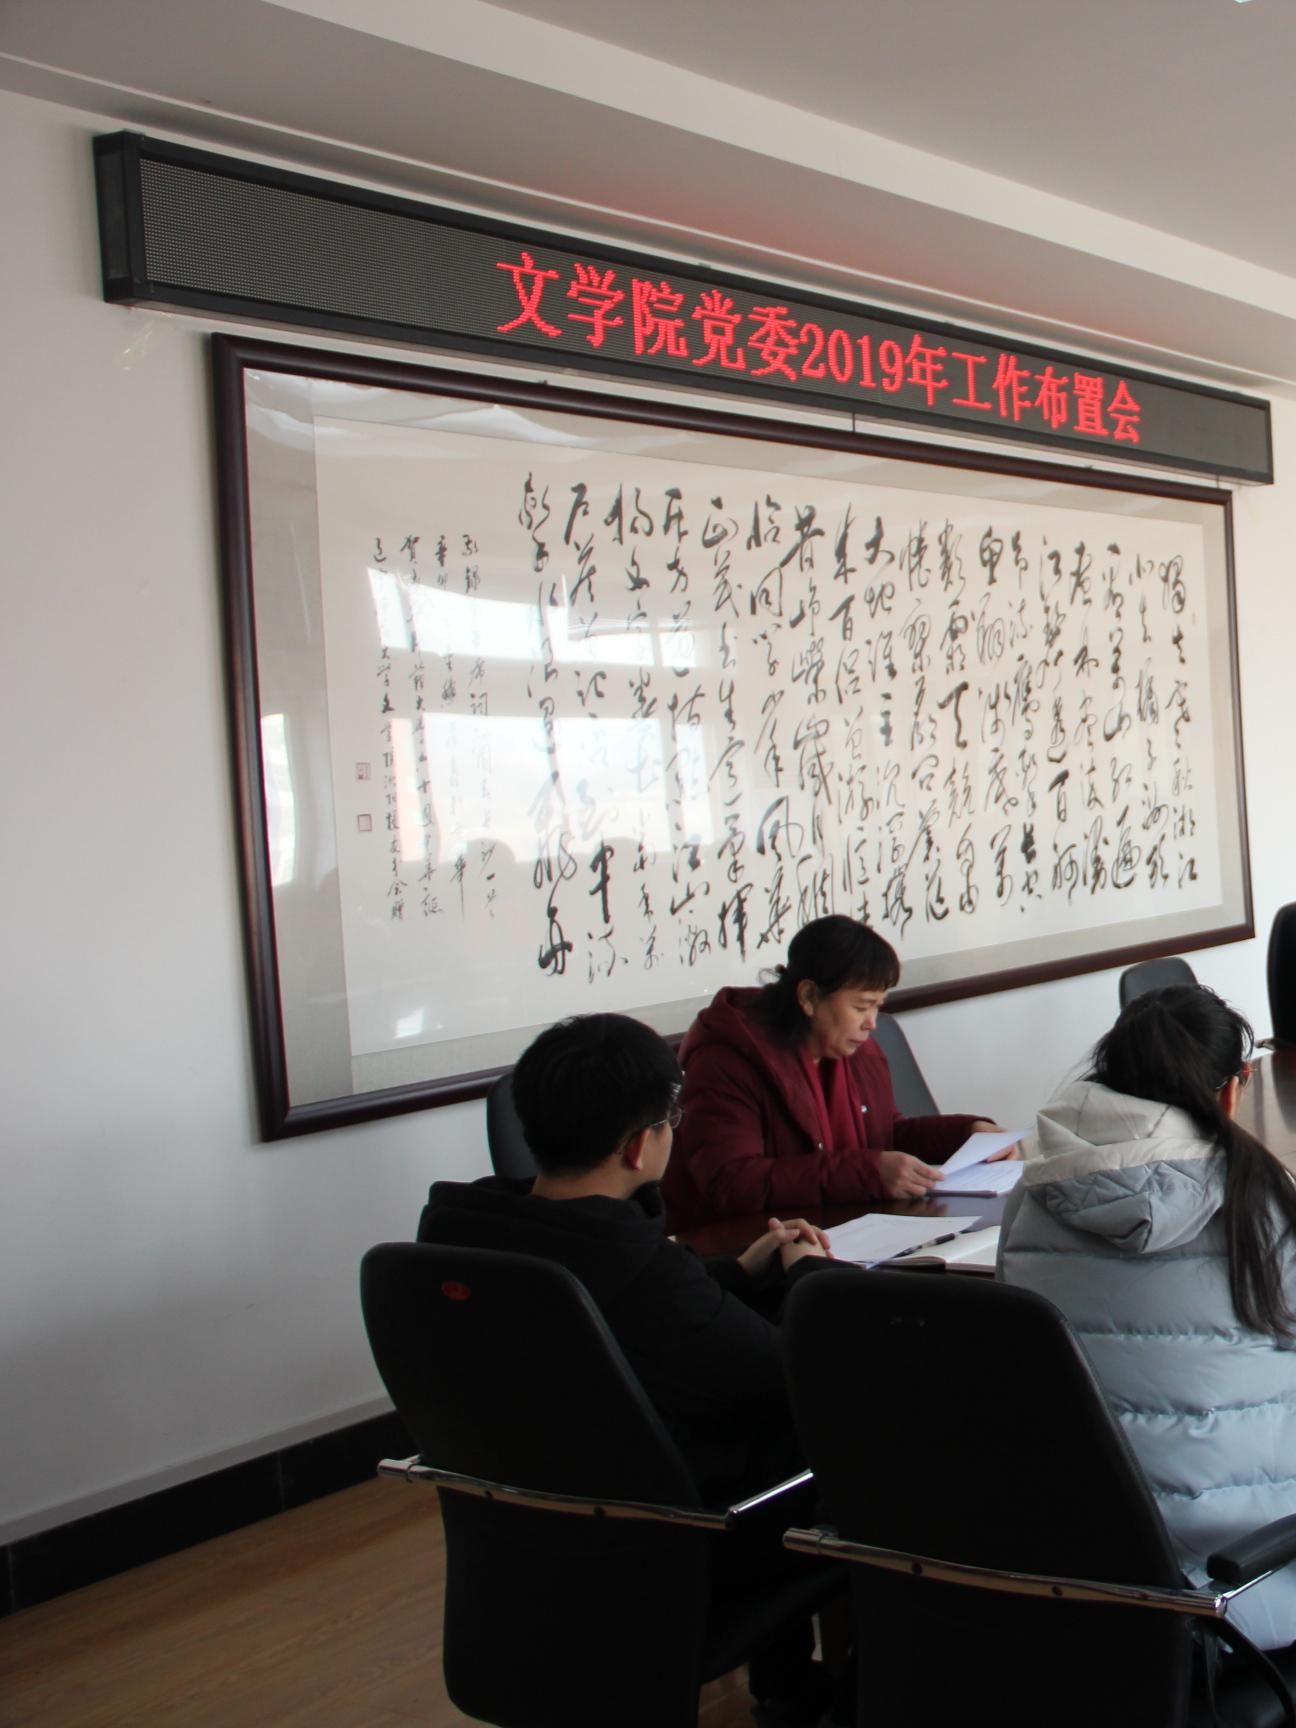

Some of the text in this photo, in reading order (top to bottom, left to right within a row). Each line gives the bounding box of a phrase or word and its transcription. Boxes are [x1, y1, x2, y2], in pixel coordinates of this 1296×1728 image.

[496, 252, 1141, 443] 文学院党委2019年工作布置会
